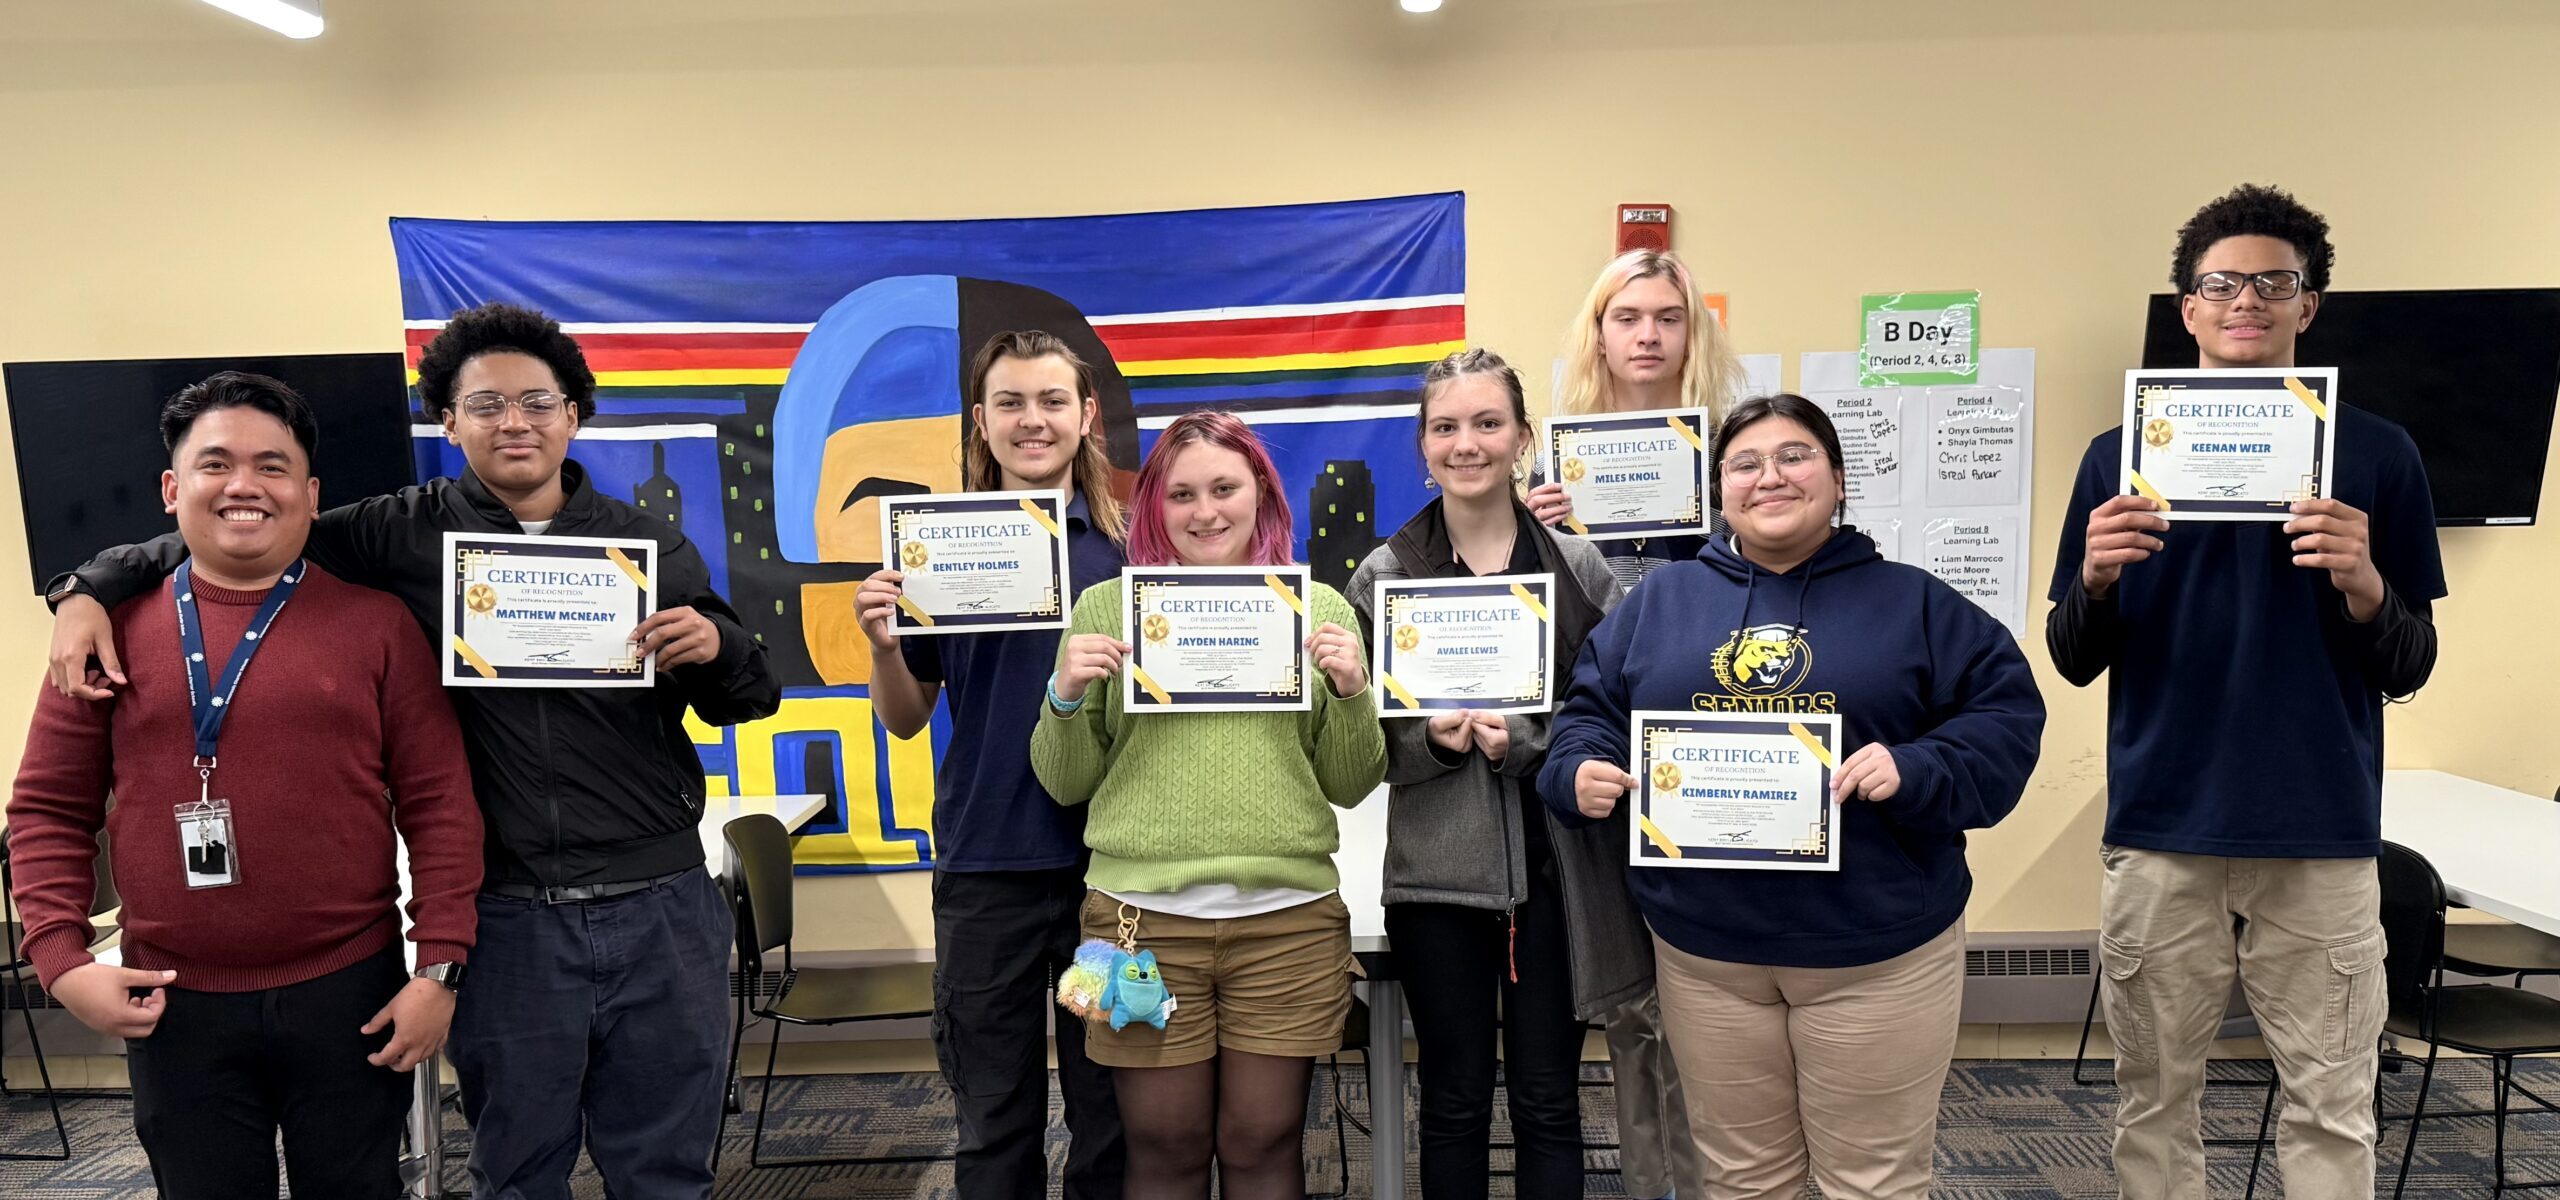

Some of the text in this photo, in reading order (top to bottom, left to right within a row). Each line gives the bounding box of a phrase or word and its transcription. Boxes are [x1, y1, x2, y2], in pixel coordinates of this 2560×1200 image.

[1885, 322, 1952, 345] B Day
[1915, 355, 1924, 366] 2,
[1928, 355, 1937, 366] 4,
[1941, 354, 1951, 365] 6,
[1837, 398, 1872, 407] Period 2
[1958, 396, 1992, 405] Period 4
[2166, 404, 2294, 418] CERTIFICATE
[1870, 419, 1889, 432] Chris
[1948, 426, 2014, 436] Onyx Gimbutas
[1577, 439, 1677, 456] CERTIFICATE
[1948, 438, 1976, 447] Shayla
[2192, 443, 2271, 453] KEENAN WEIR
[1939, 450, 2002, 464] Chris Lopez
[1595, 472, 1660, 483] MILES KNOLL
[918, 523, 1032, 540] CERTIFICATE
[1954, 526, 1982, 534] Period
[1944, 537, 1999, 545] Learning Lab
[933, 560, 1019, 572] BENTLEY HOLMES
[1941, 567, 1961, 575] Lyric
[488, 569, 617, 587] CERTIFICATE
[1976, 589, 1997, 597] Tapia
[1161, 600, 1275, 613] CERTIFICATE
[496, 609, 615, 622] MATTHEW MCNEARY
[1411, 608, 1520, 623] CERTIFICATE
[1177, 637, 1259, 646] JAYDEN HARING
[1437, 646, 1498, 655] AVALEE LEWIS
[1692, 692, 1836, 714] SENIORS
[1672, 747, 1800, 764] CERTIFICATE
[1682, 788, 1797, 801] KIMBERLY RAMIREZ
